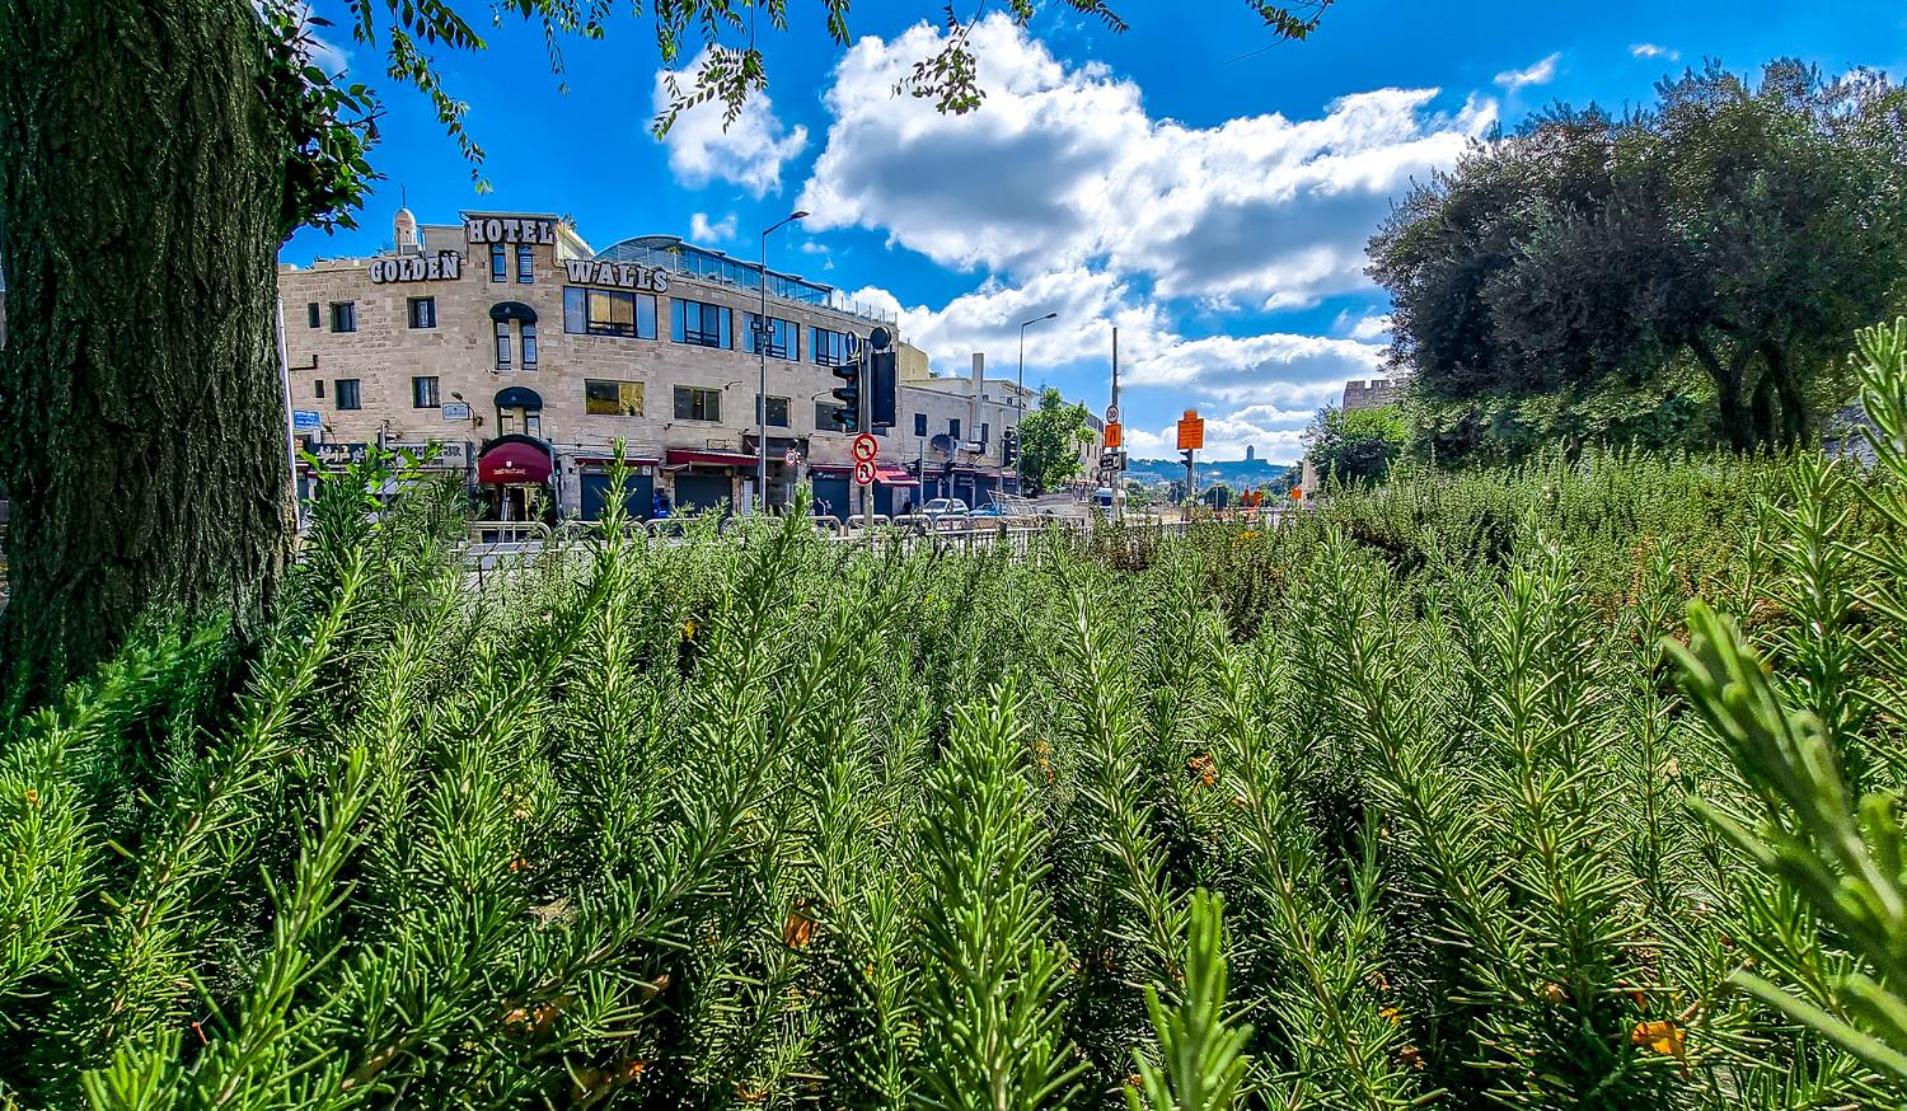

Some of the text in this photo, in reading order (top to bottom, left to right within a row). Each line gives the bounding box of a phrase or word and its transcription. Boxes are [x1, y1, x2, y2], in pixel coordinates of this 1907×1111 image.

[468, 219, 555, 245] HOTEL
[370, 254, 460, 284] GOLDEN
[565, 260, 668, 292] WALLS
